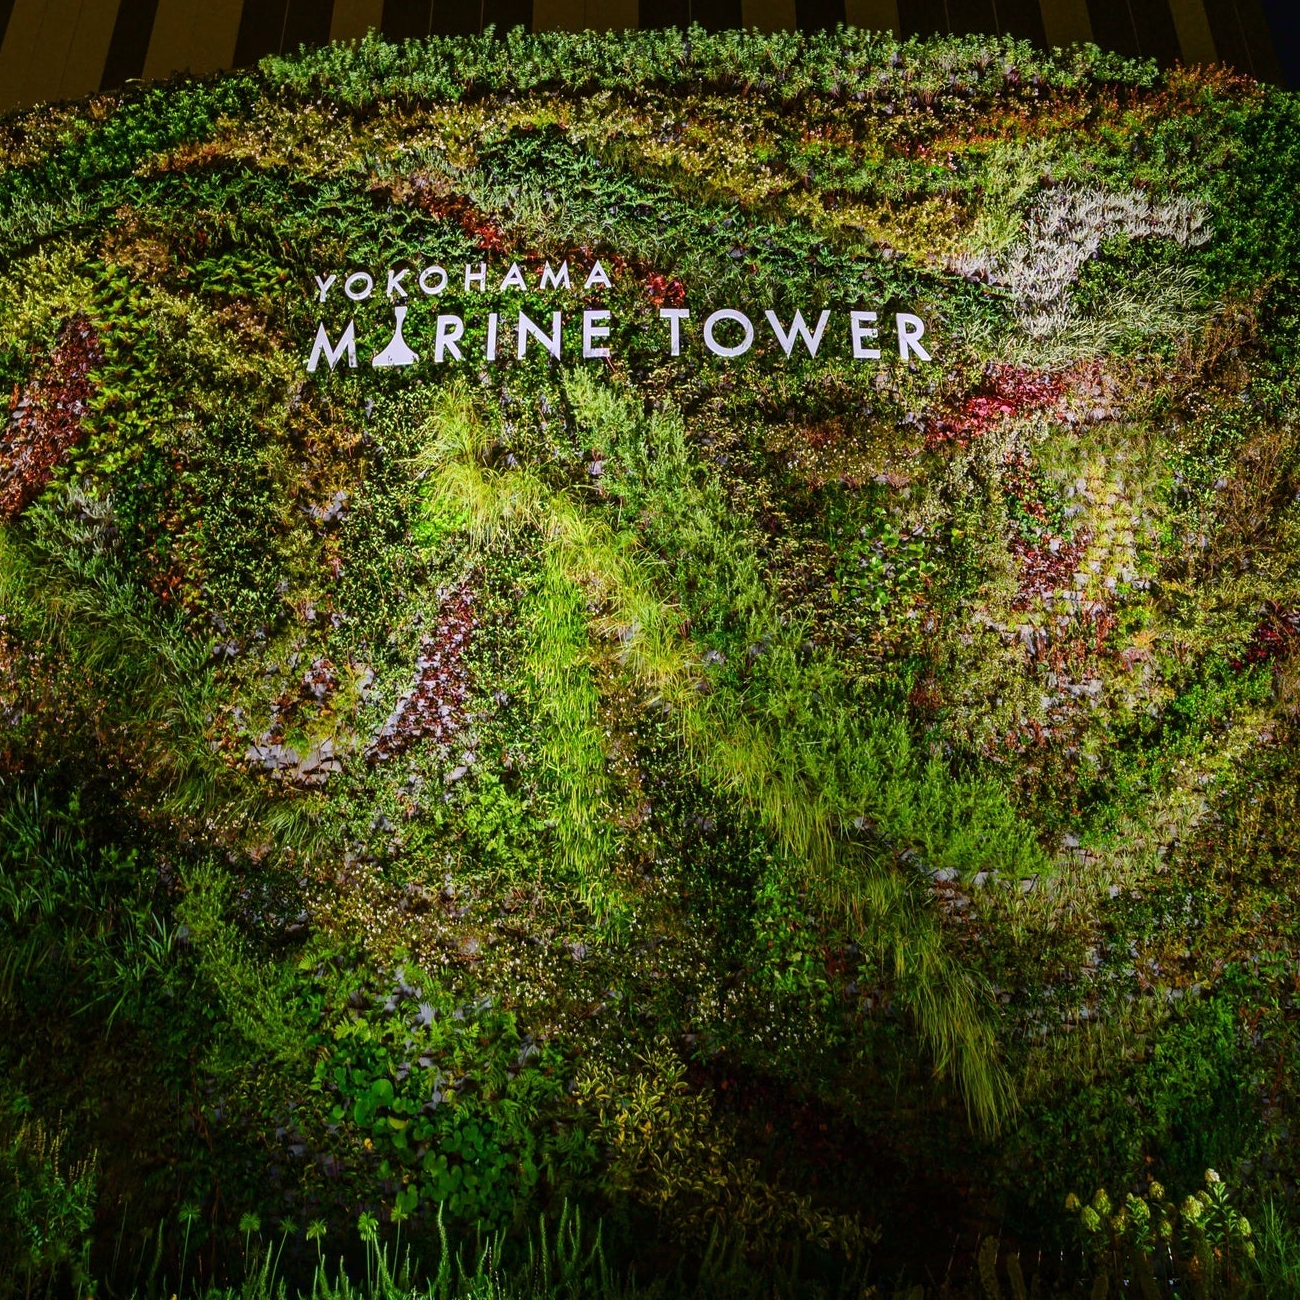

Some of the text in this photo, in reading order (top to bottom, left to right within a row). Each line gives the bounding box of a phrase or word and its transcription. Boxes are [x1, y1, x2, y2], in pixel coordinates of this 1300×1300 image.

[314, 259, 612, 302] YOKOHAMA
[306, 305, 932, 372] MARINE TOWER
